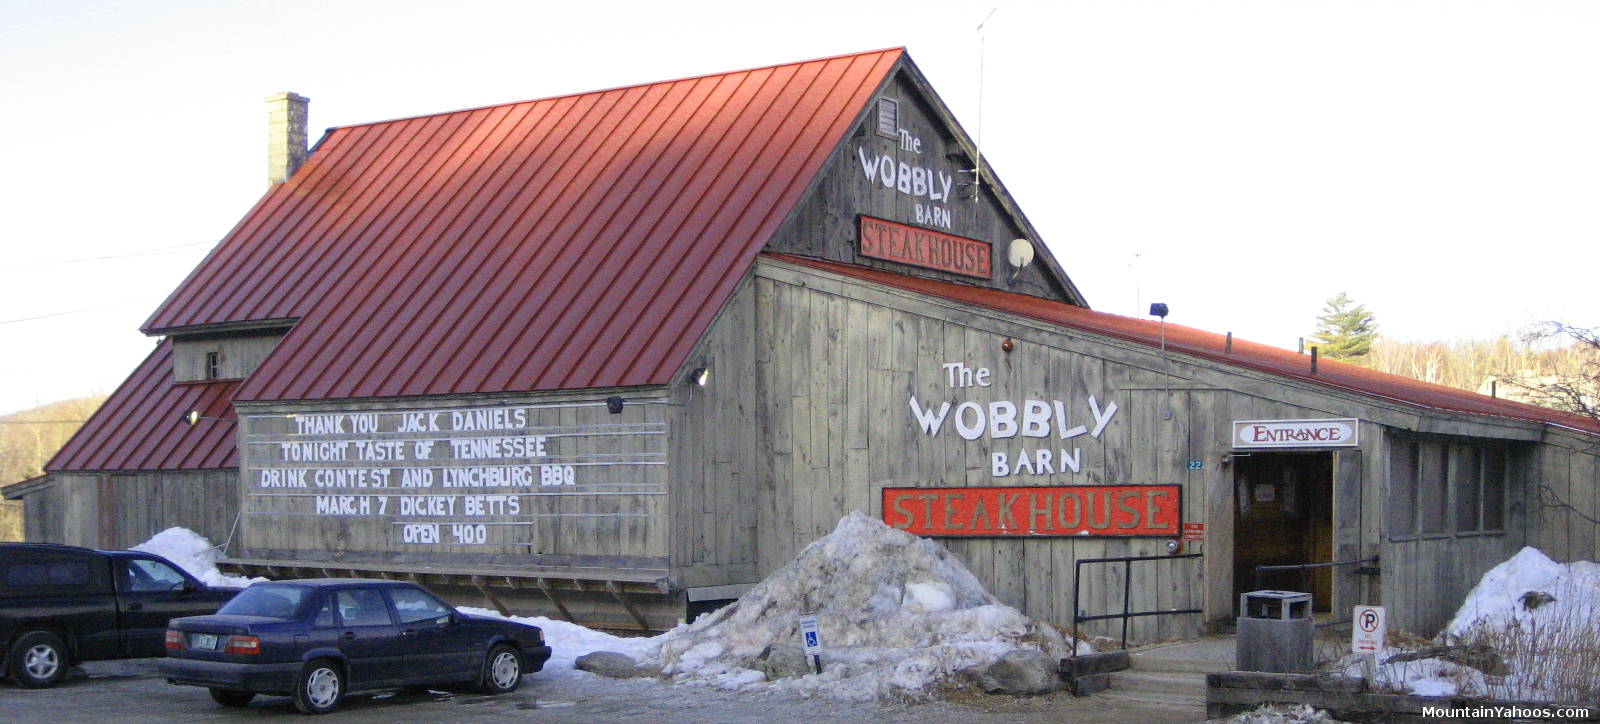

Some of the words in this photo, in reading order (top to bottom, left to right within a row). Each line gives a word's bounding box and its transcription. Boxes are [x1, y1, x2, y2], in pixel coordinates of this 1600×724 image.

[899, 128, 921, 153] The
[858, 146, 952, 203] WOBBLY
[915, 204, 951, 229] BARN
[943, 362, 992, 388] The
[296, 415, 344, 435] THANK
[350, 413, 378, 434] YOU
[398, 411, 440, 433] JACK
[453, 408, 526, 431] DANIELS
[909, 394, 1119, 440] WOBBLY
[282, 441, 349, 461] TONIGHT
[356, 440, 405, 461] TASTE
[415, 440, 434, 460] OF
[451, 436, 547, 459] TENNESSEE
[991, 447, 1081, 477] BARN
[260, 468, 308, 488] DRINK
[315, 467, 391, 488] CONTEST
[402, 466, 433, 488] AND
[443, 464, 533, 488] LYNCHBURG
[541, 463, 575, 486] BBQ
[316, 495, 370, 515] MARCH
[377, 495, 388, 515] 7
[401, 495, 456, 516] DICKEY
[464, 494, 520, 516] BETTS
[404, 523, 440, 544] OPEN
[453, 522, 487, 544] 400
